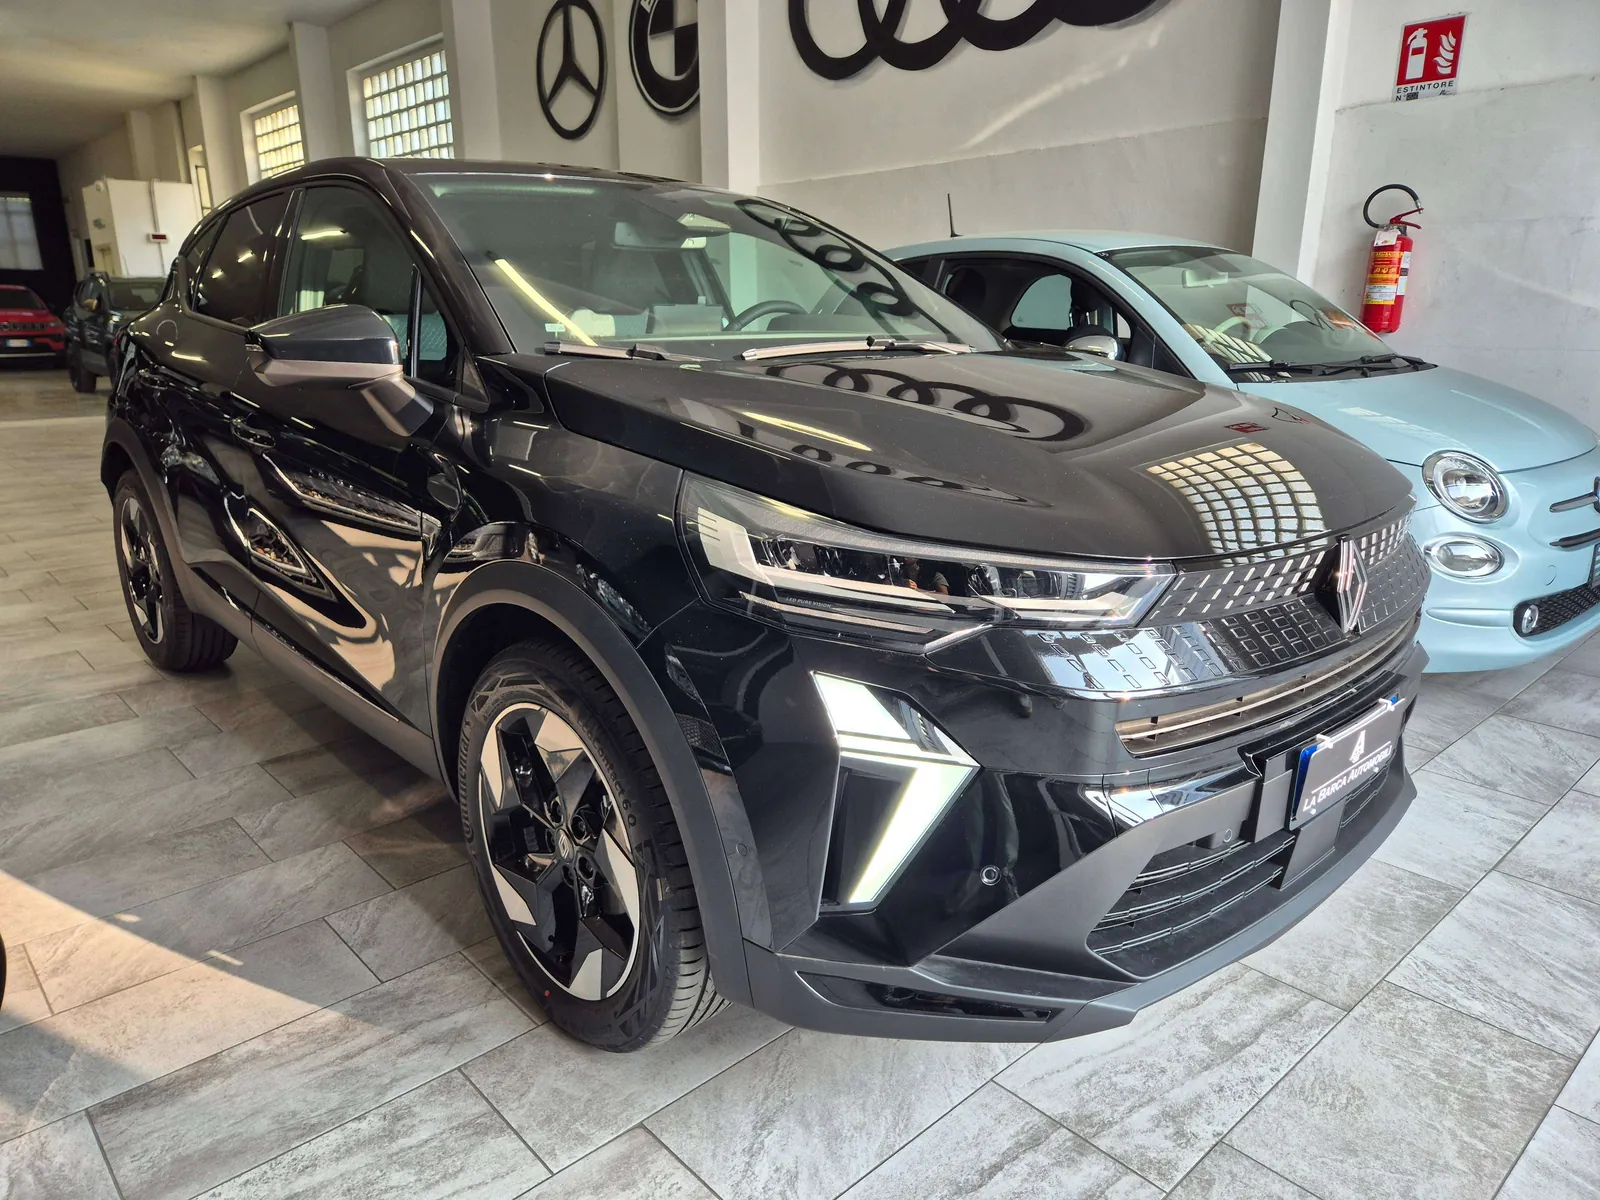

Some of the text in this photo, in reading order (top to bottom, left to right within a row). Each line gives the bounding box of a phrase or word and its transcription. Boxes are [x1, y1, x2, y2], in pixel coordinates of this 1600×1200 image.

[1396, 80, 1454, 94] ESTINTORE
[1303, 744, 1393, 811] LA BARCA AUTOMOBILI
